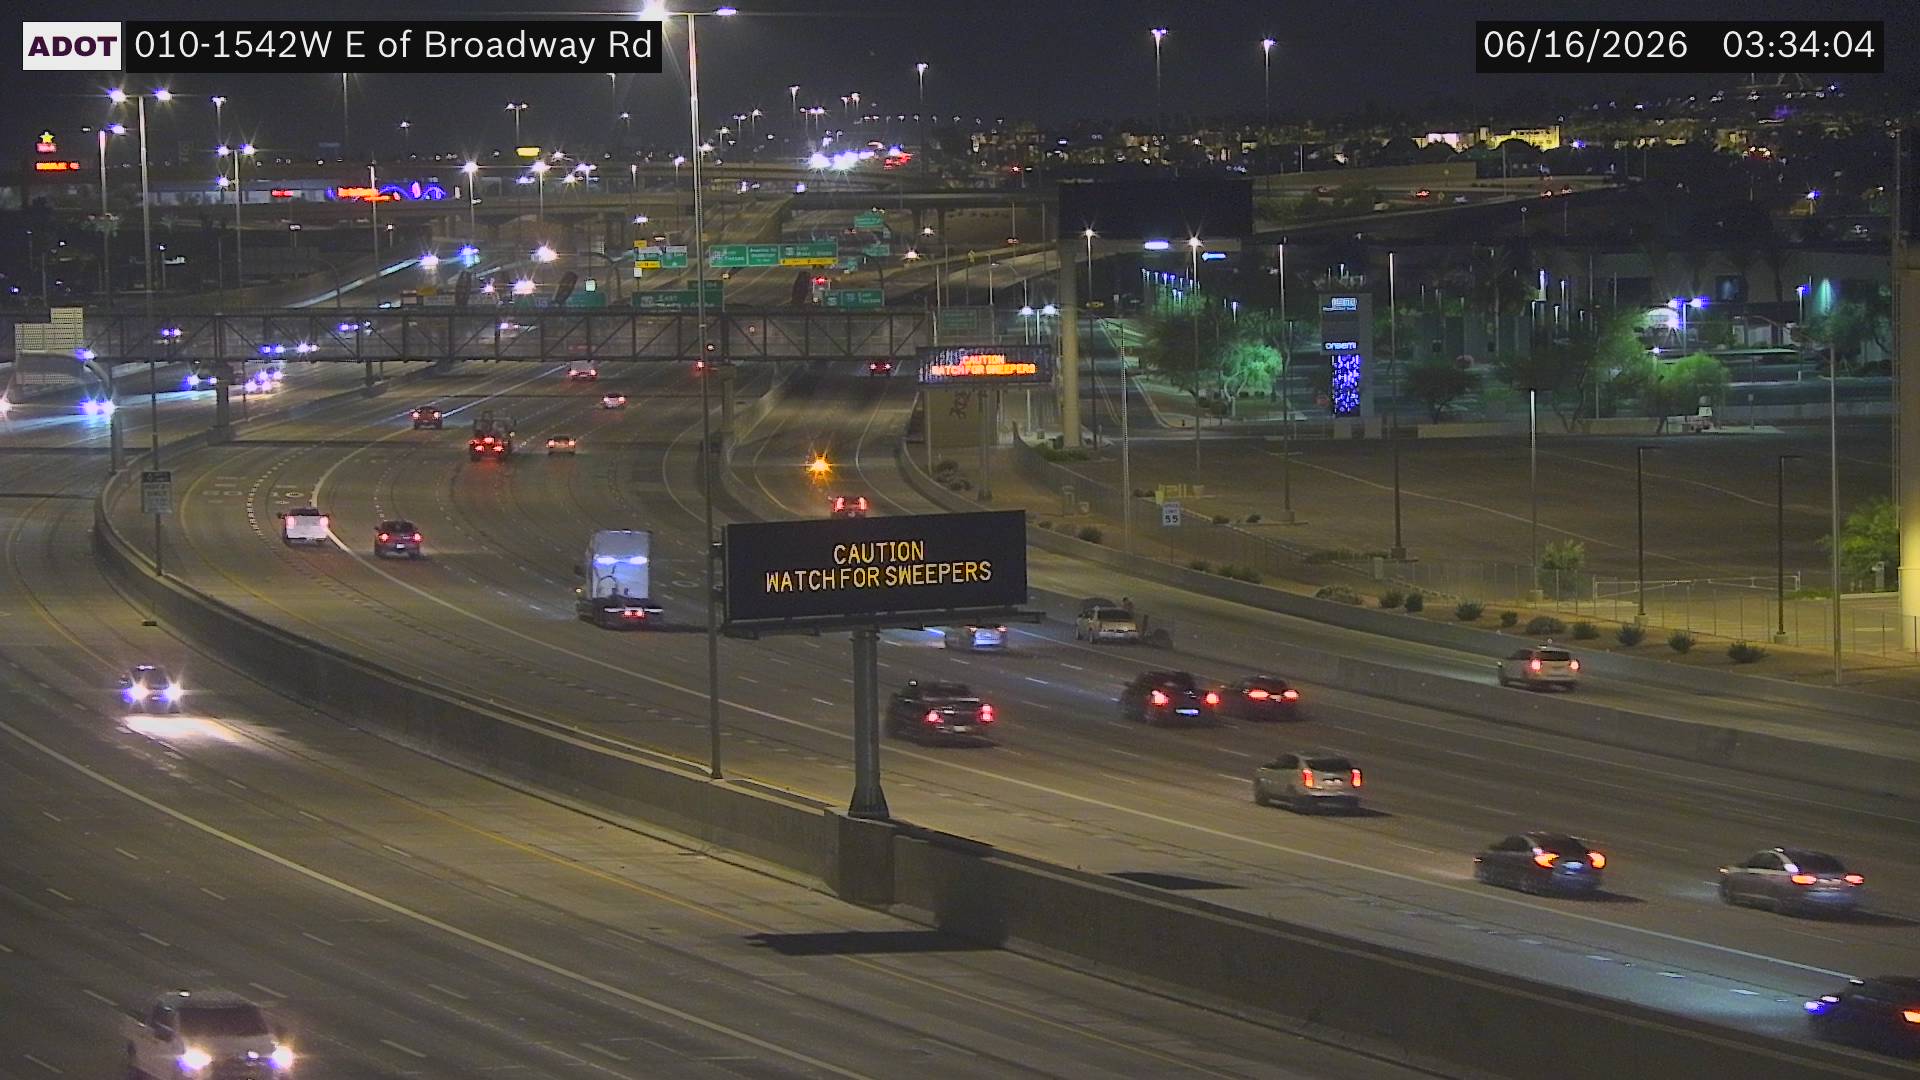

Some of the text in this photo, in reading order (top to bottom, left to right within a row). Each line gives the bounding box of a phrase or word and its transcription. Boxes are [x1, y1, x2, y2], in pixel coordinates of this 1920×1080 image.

[1325, 342, 1357, 350] onsemi
[1165, 514, 1179, 523] 55
[833, 540, 925, 566] CAUTION
[765, 560, 992, 594] WATCH FOR SWEEPERS
